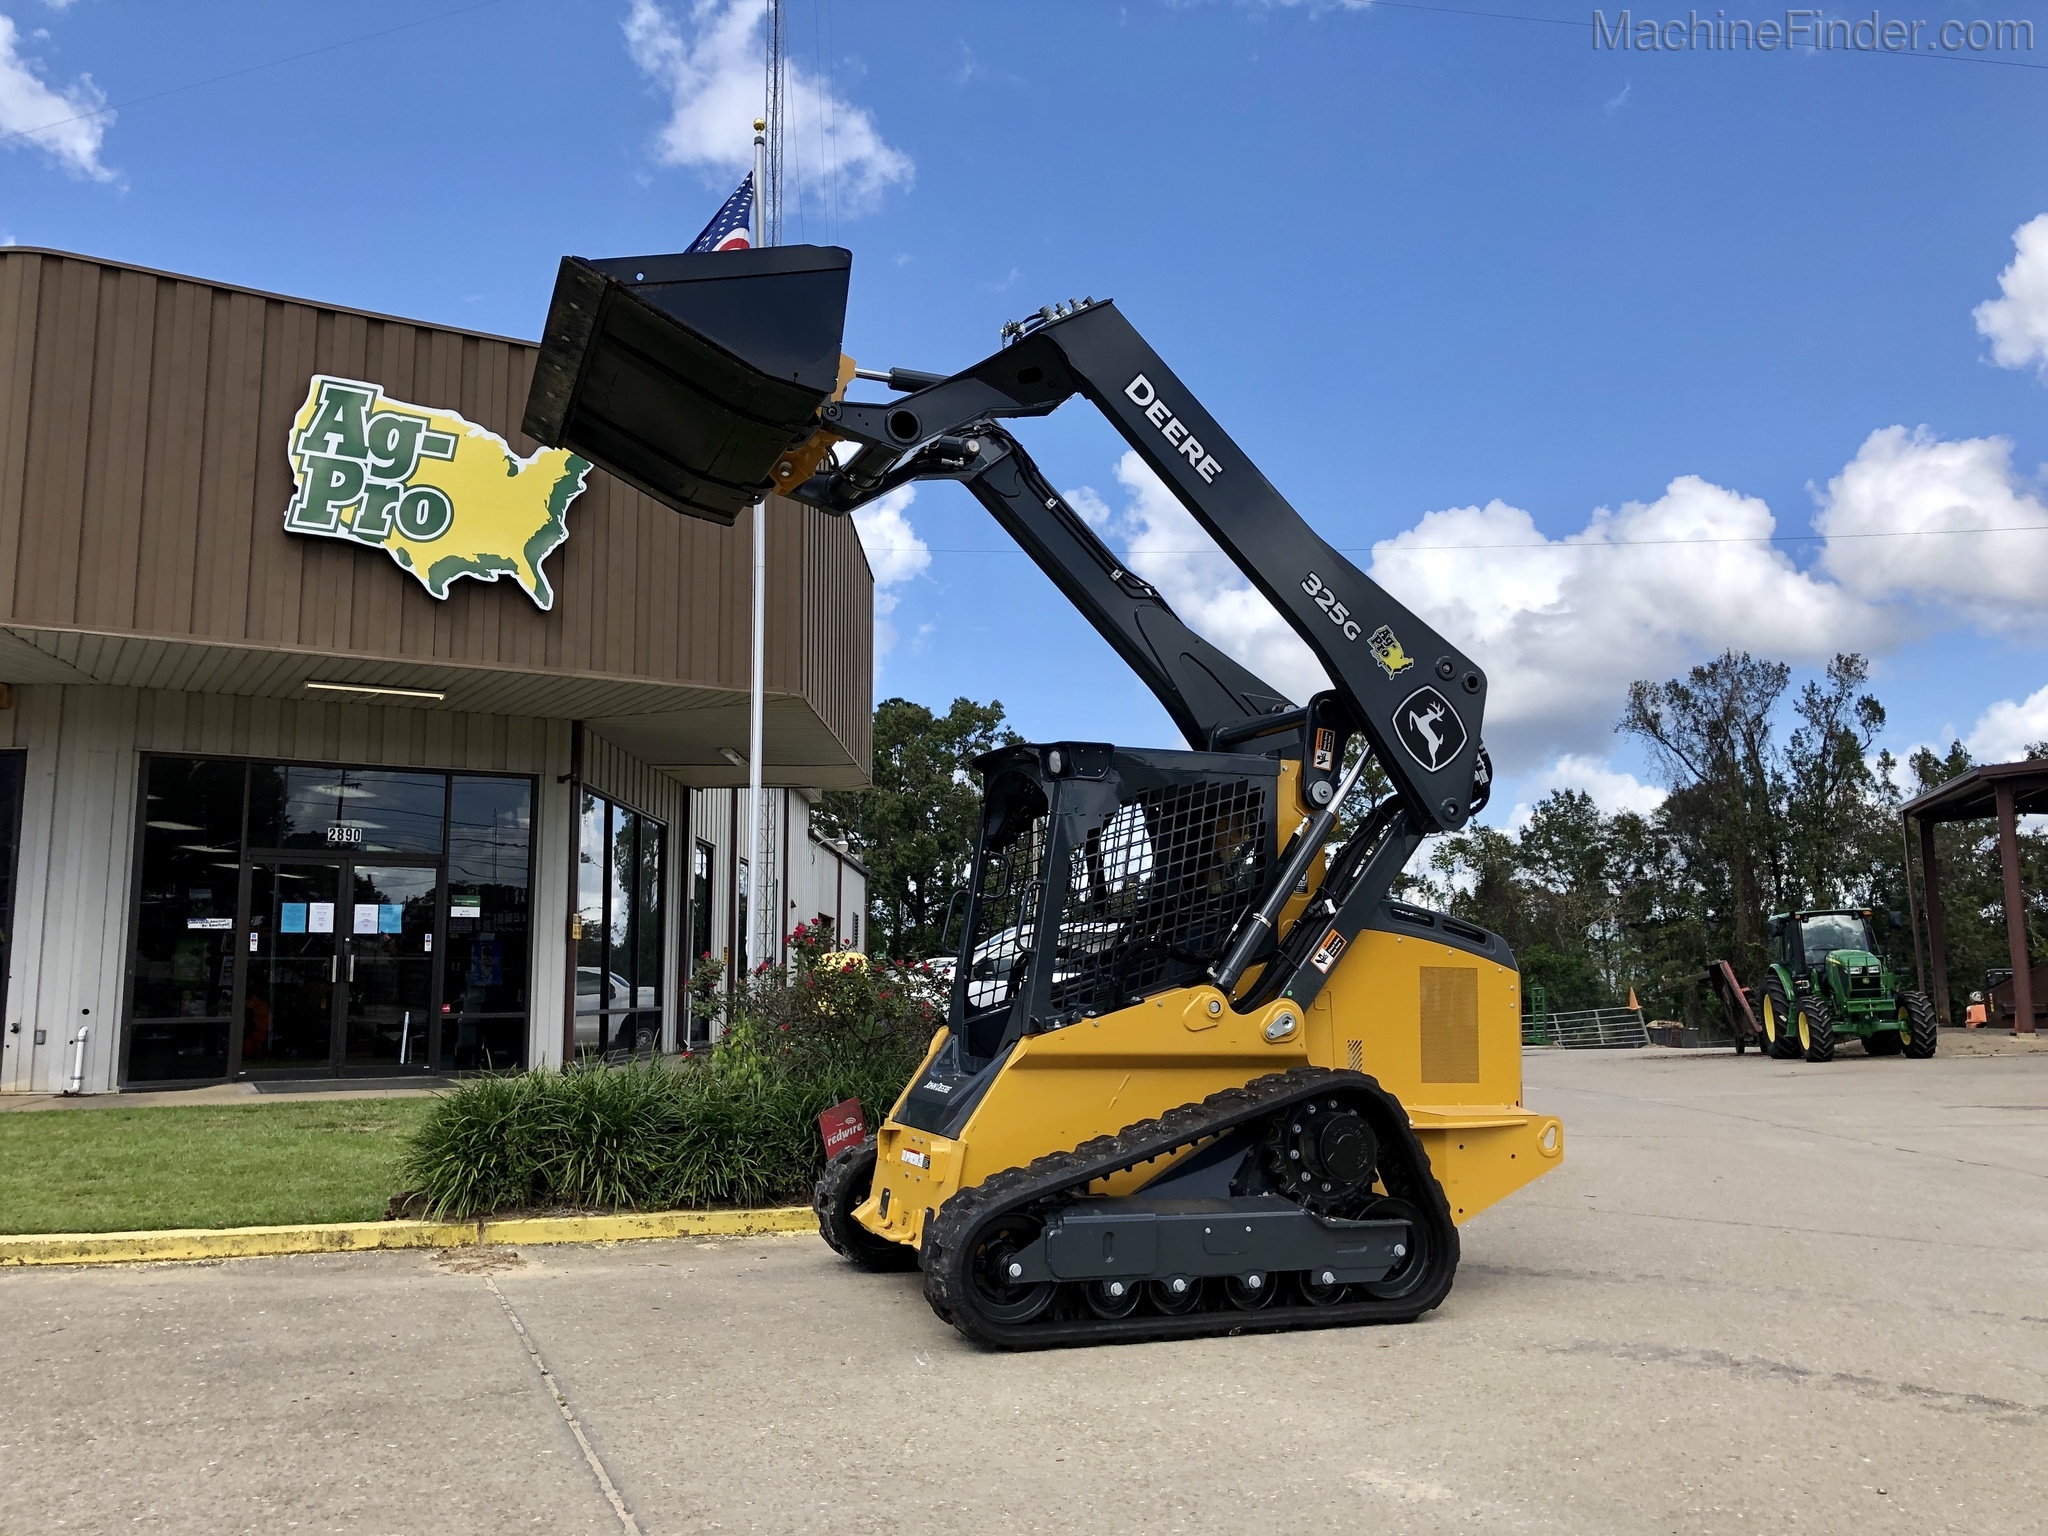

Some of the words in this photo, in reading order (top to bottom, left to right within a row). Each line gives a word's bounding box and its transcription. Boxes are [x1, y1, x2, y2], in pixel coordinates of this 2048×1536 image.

[295, 383, 457, 483] Ag-
[1124, 373, 1223, 484] DEERE
[291, 455, 453, 540] Pro
[1301, 572, 1362, 641] 325G
[1370, 634, 1390, 658] Pro
[1378, 628, 1397, 648] Ag-
[328, 828, 361, 842] 2890
[827, 1122, 863, 1147] redwire
